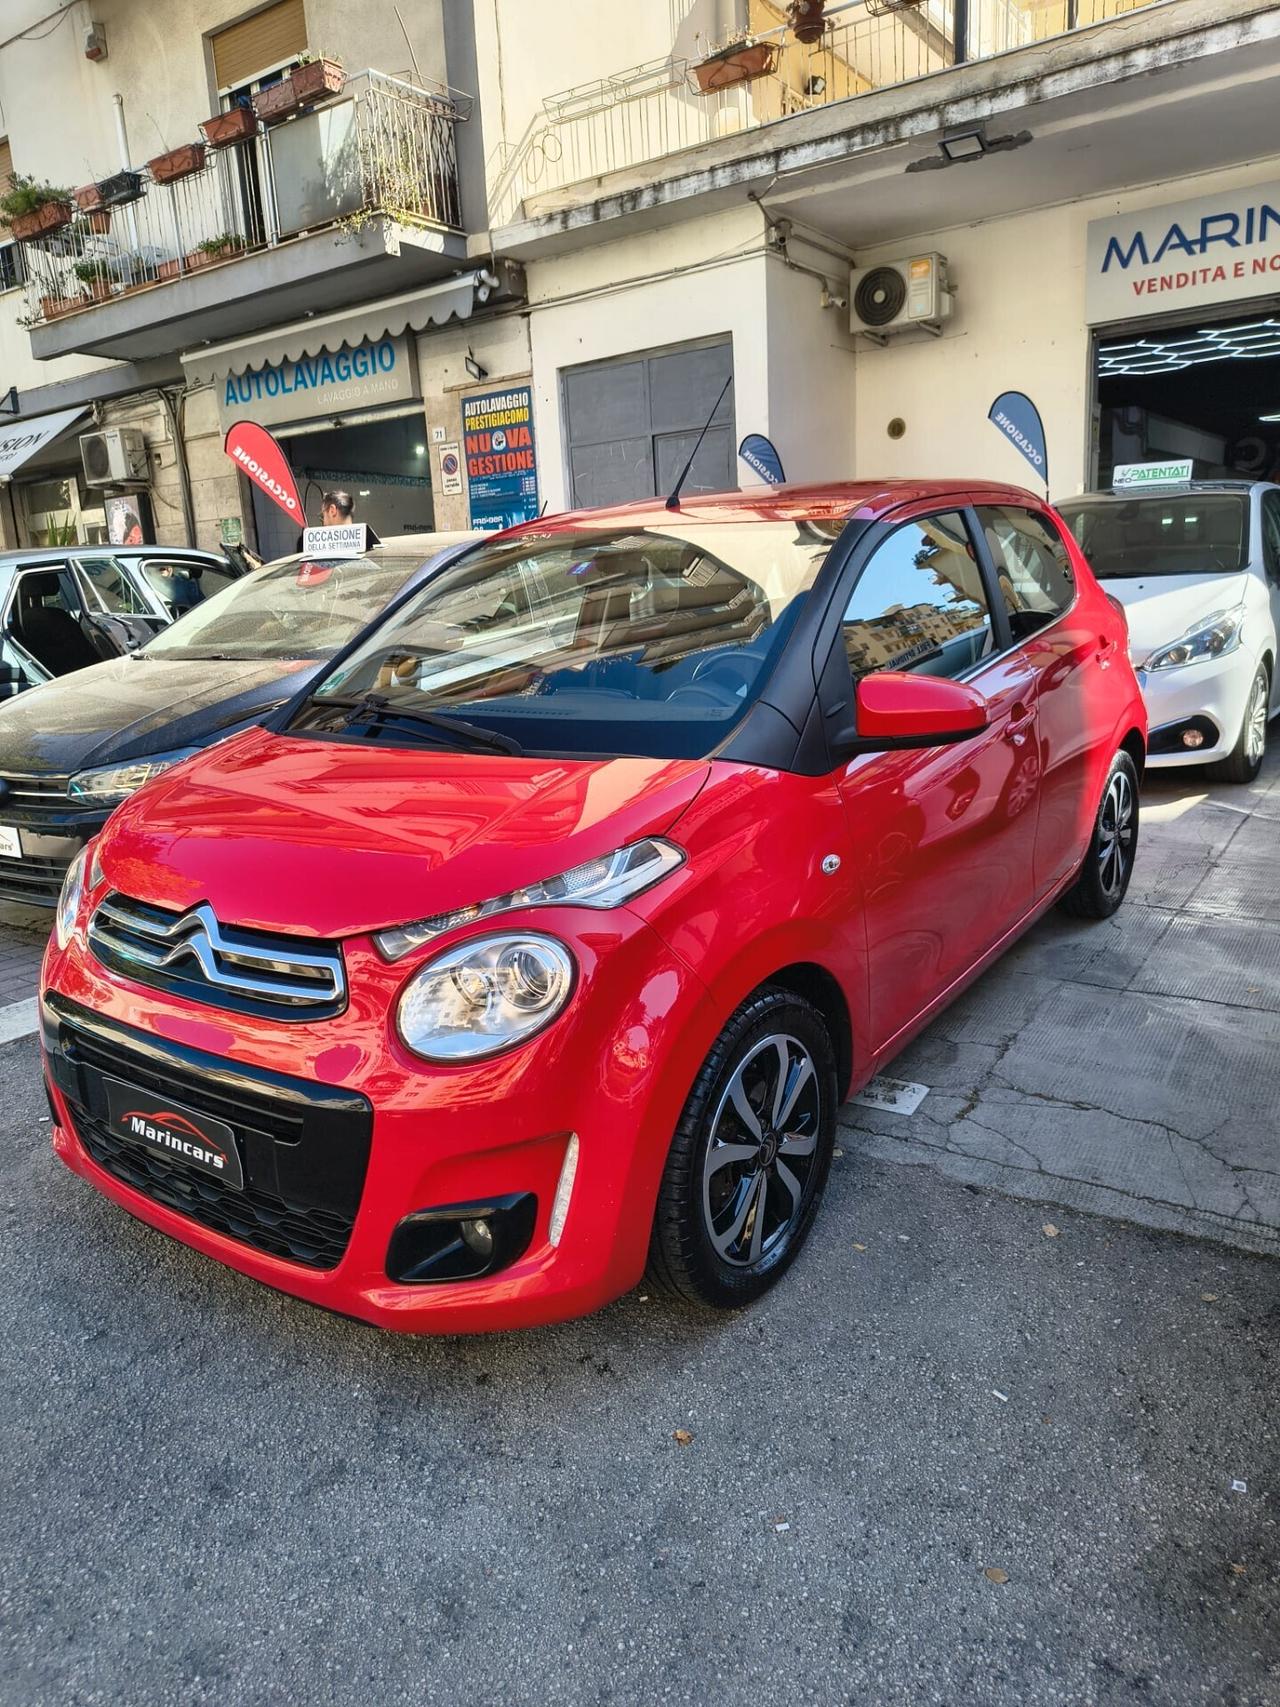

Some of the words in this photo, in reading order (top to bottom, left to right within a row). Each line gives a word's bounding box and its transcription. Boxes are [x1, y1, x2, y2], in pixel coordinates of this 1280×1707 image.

[1133, 265, 1226, 296] VENDITA
[1233, 261, 1245, 278] E
[225, 341, 395, 407] AUTOLAVAGGIO
[318, 387, 361, 405] LAVAGGIO
[371, 379, 398, 393] MANO
[465, 392, 528, 417] AUTOLAVAGGIO
[465, 407, 529, 432] PRESTIGIACOMO
[435, 430, 443, 439] 71
[468, 449, 534, 477] GESTIONE
[1131, 465, 1189, 479] PATENTATI
[1113, 477, 1132, 485] NEO
[308, 528, 361, 543] OCCASIONE
[308, 542, 327, 551] DELLA
[328, 540, 361, 549] SETTIMANA
[131, 1116, 224, 1169] Marincars
